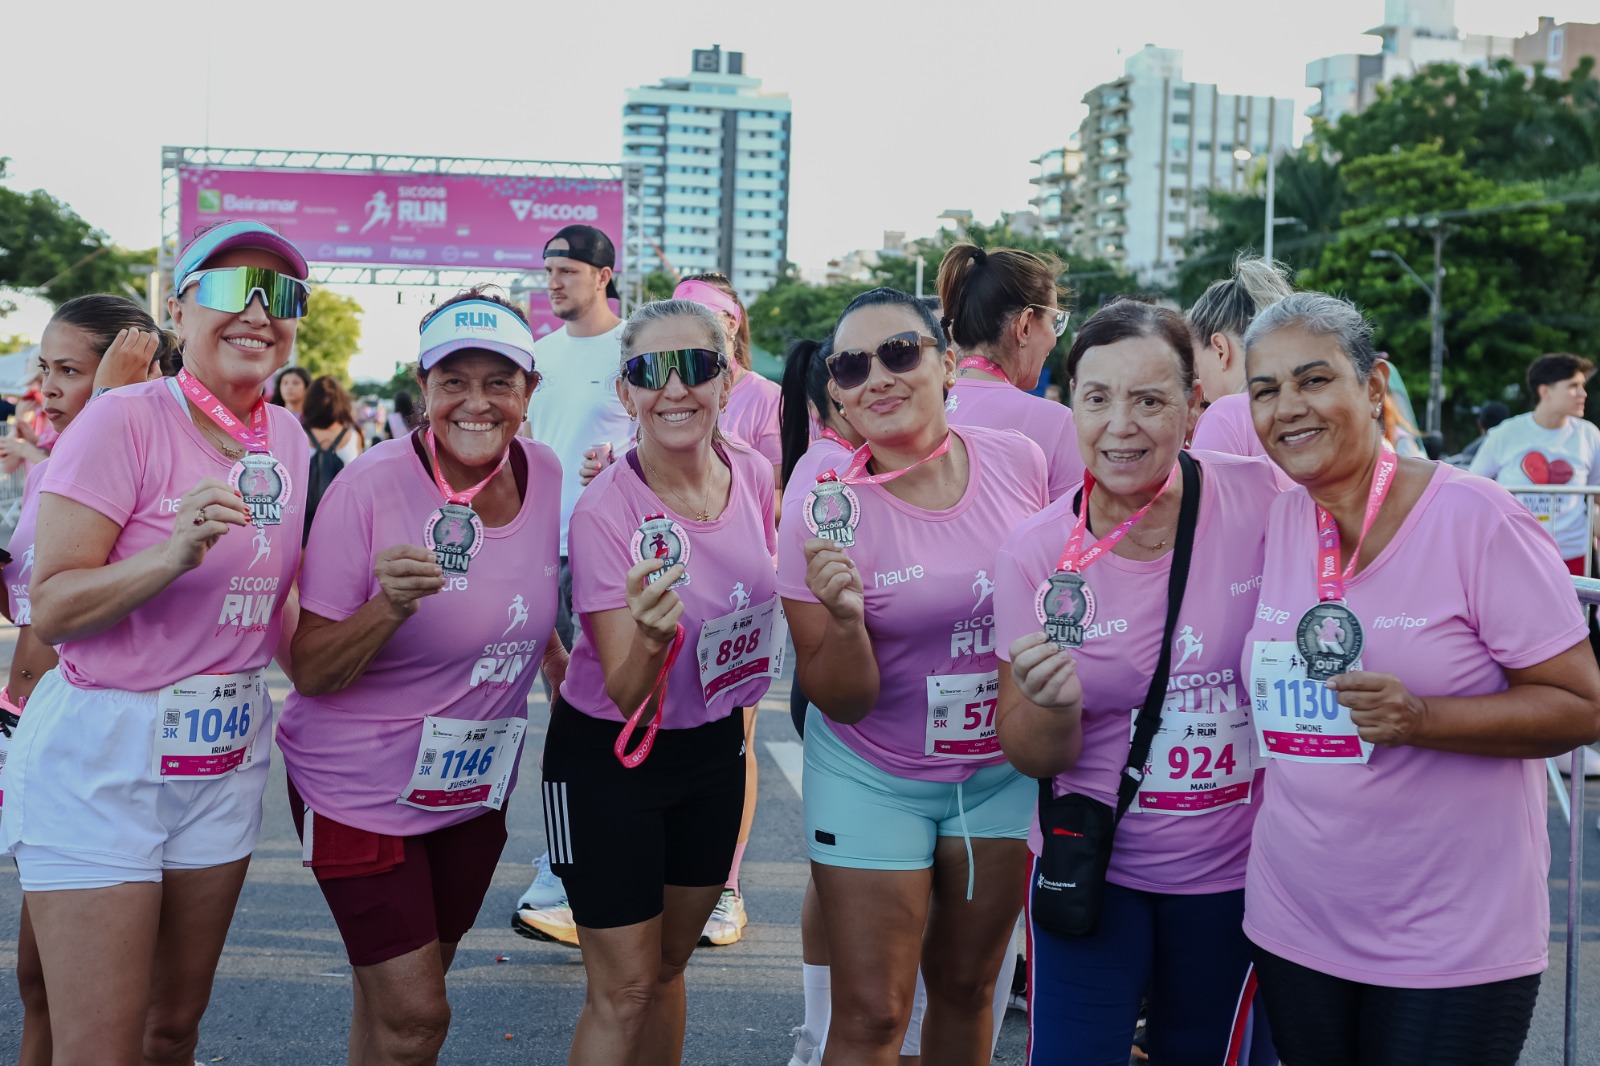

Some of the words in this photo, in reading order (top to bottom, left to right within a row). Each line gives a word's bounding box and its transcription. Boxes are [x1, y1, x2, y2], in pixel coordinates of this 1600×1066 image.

[398, 186, 447, 198] SICOOB
[223, 194, 298, 213] Beiramar
[398, 200, 447, 222] RUN
[532, 203, 598, 221] SICOOB
[455, 311, 497, 328] RUN
[1375, 466, 1389, 496] SICOOB
[229, 576, 279, 592] SICOOB
[441, 576, 468, 592] ure
[874, 564, 924, 589] haure
[11, 585, 30, 596] SIC
[1230, 575, 1263, 597] florip
[218, 594, 276, 627] RUN
[739, 619, 753, 629] RUN
[953, 614, 995, 632] SICO
[1083, 618, 1128, 640] aure
[1373, 612, 1428, 630] floripa
[1045, 623, 1082, 643] RUN
[481, 639, 537, 657] SICOOB
[716, 627, 761, 666] 898
[951, 627, 997, 658] RU
[470, 655, 532, 687] RUN
[1316, 659, 1342, 671] OUT
[986, 683, 998, 692] RU
[1166, 668, 1235, 692] ICOOB
[223, 688, 237, 698] RUN
[1273, 678, 1339, 721] 1130
[1256, 699, 1269, 711] 3K
[184, 702, 251, 743] 1046
[933, 719, 948, 728] 5K
[963, 698, 998, 731] 57
[162, 727, 179, 739] 3K
[472, 733, 487, 741] RUN
[980, 729, 997, 738] MAR
[1197, 727, 1217, 737] RUN
[1295, 723, 1323, 733] SIMONE
[632, 730, 653, 763] SICOOB
[418, 765, 432, 776] 3K
[440, 746, 496, 779] 1146
[1168, 743, 1236, 780] 924
[447, 778, 478, 790] JUREMA
[1190, 782, 1218, 791] MARIA
